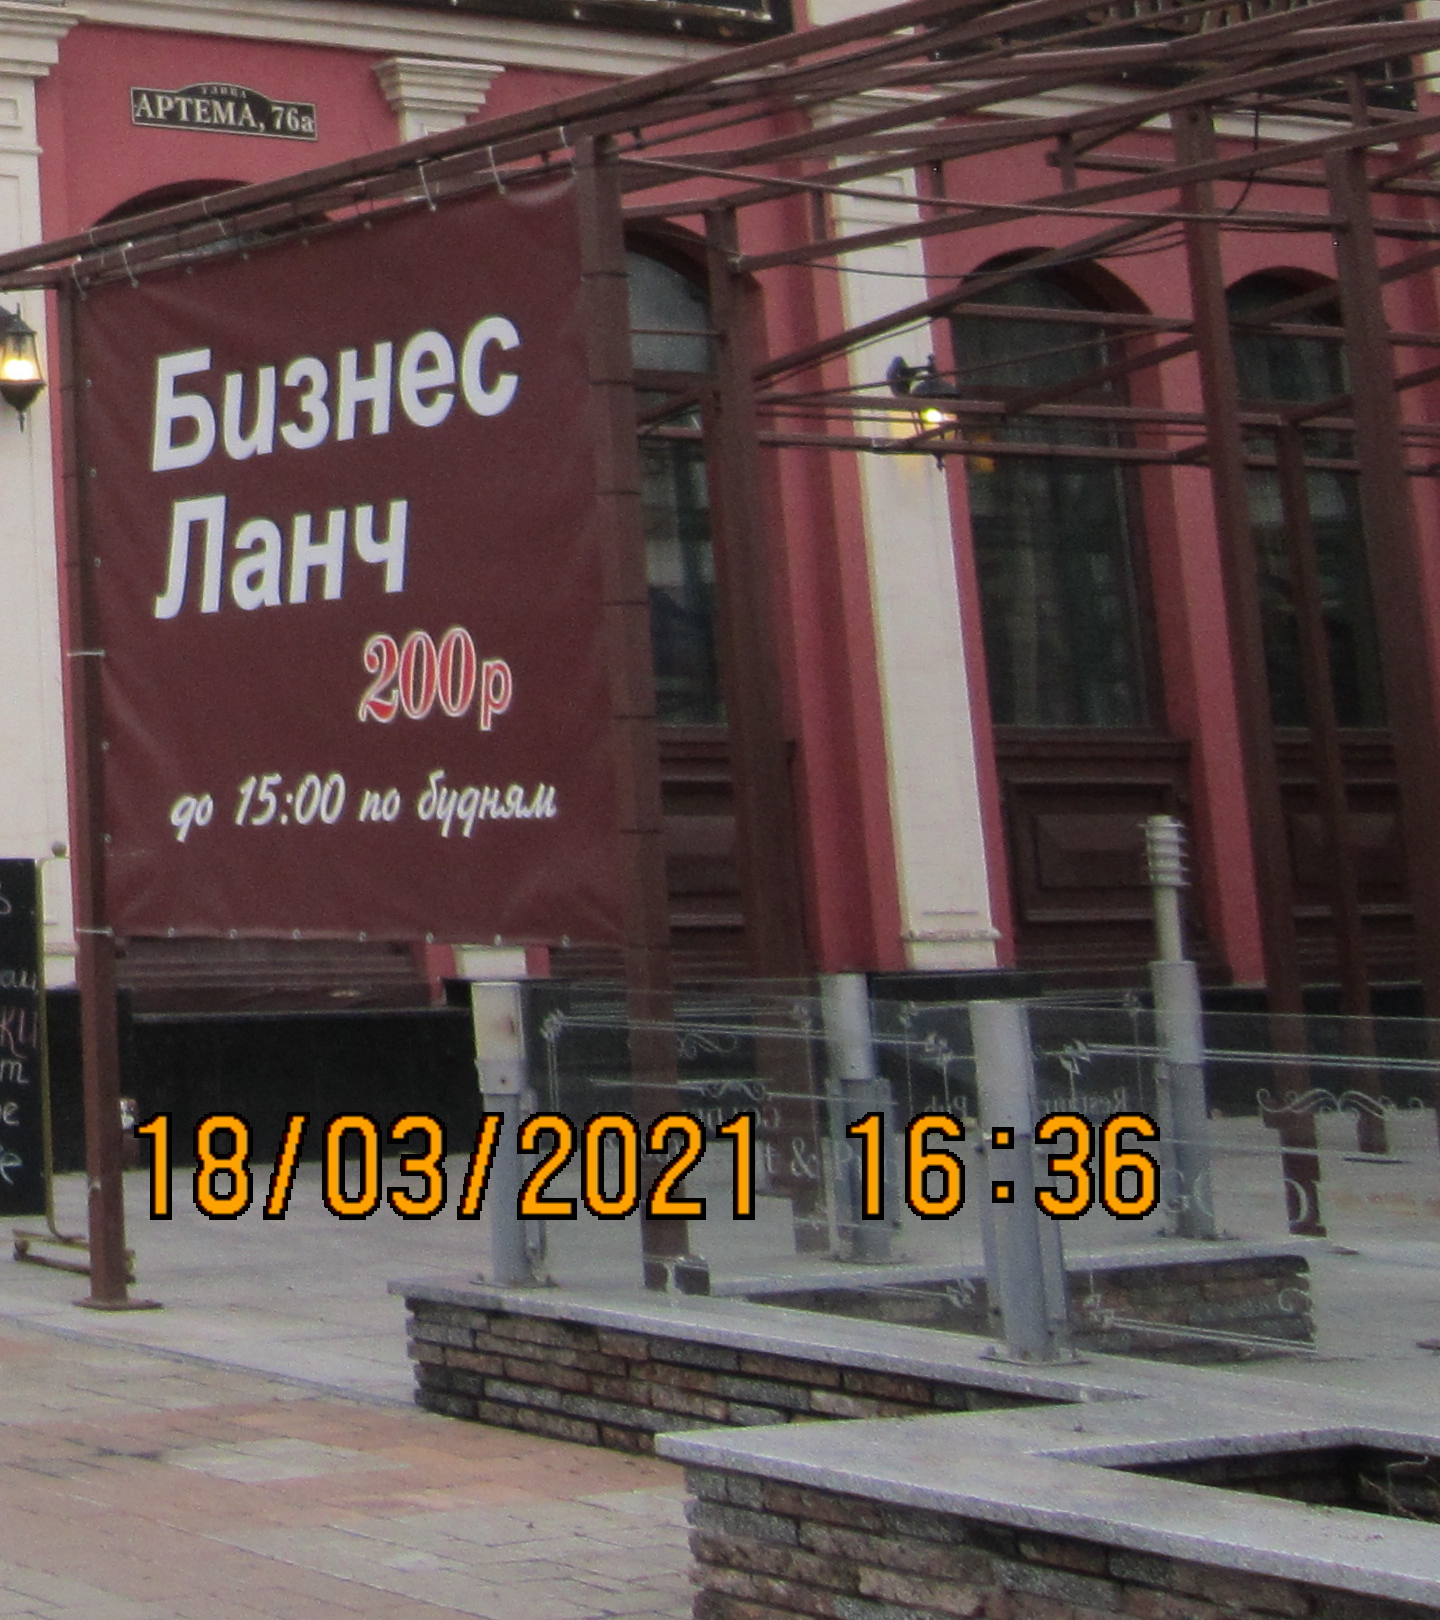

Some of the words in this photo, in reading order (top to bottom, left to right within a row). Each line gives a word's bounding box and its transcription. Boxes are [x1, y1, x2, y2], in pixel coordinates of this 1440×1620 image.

[135, 93, 266, 131] АРТЕМА,
[152, 314, 520, 472] Бизнес
[154, 494, 408, 619] Ланч
[358, 627, 513, 731] 200р
[170, 792, 214, 842] до
[235, 773, 346, 826] 15:00
[358, 787, 400, 823] по
[418, 770, 558, 838] будням
